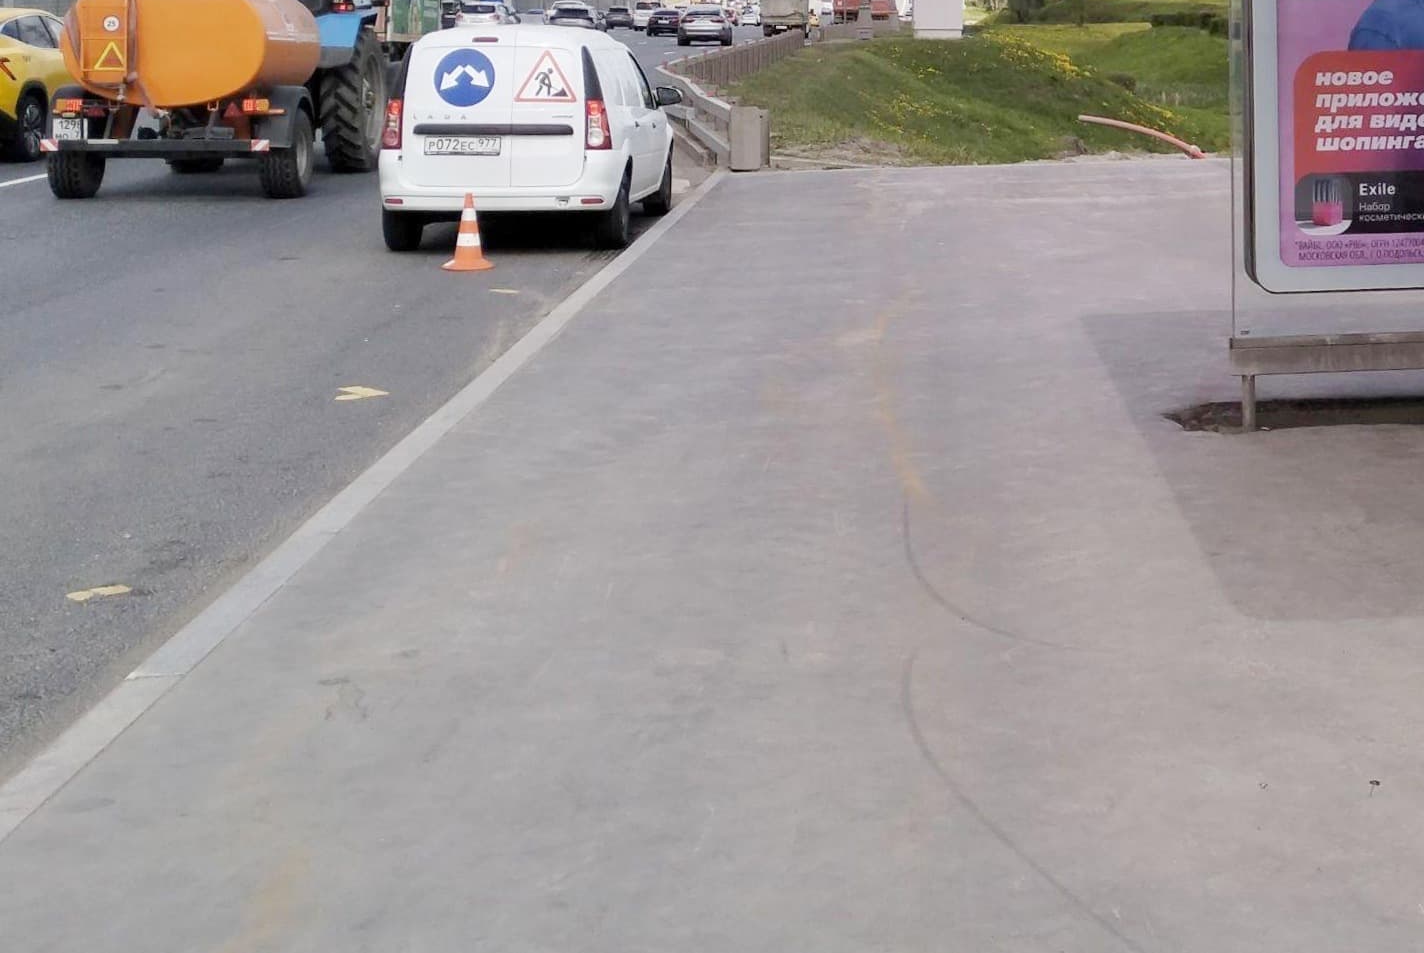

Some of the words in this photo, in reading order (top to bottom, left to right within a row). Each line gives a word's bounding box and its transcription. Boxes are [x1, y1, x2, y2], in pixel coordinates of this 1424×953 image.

[1315, 70, 1394, 86] новое
[1314, 114, 1363, 133] для
[478, 139, 496, 148] 977
[1359, 182, 1396, 196] Exile
[1359, 201, 1391, 212] Набор
